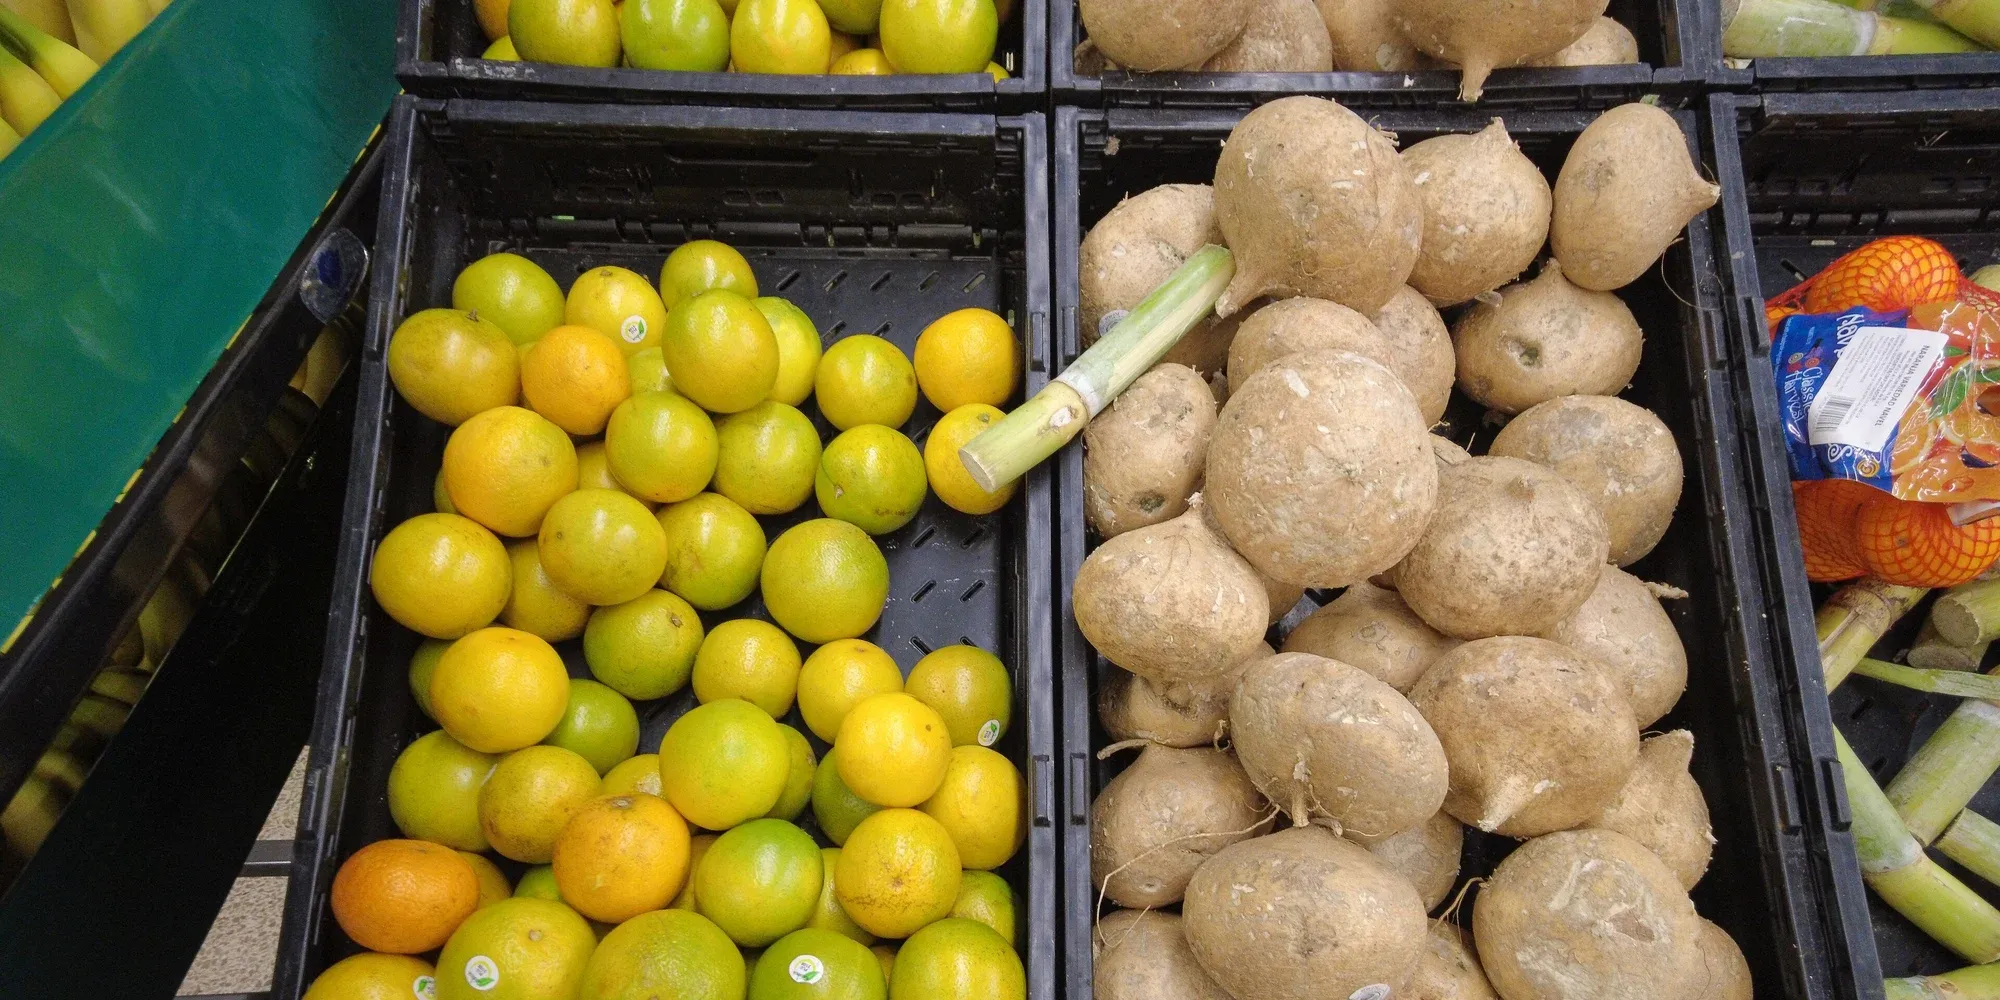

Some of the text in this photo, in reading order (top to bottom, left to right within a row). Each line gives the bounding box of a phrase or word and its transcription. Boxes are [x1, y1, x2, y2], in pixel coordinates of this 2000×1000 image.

[1908, 344, 1930, 375] NARANJA
[1888, 376, 1911, 407] VARIEDAD
[1875, 407, 1892, 426] NAVEL
